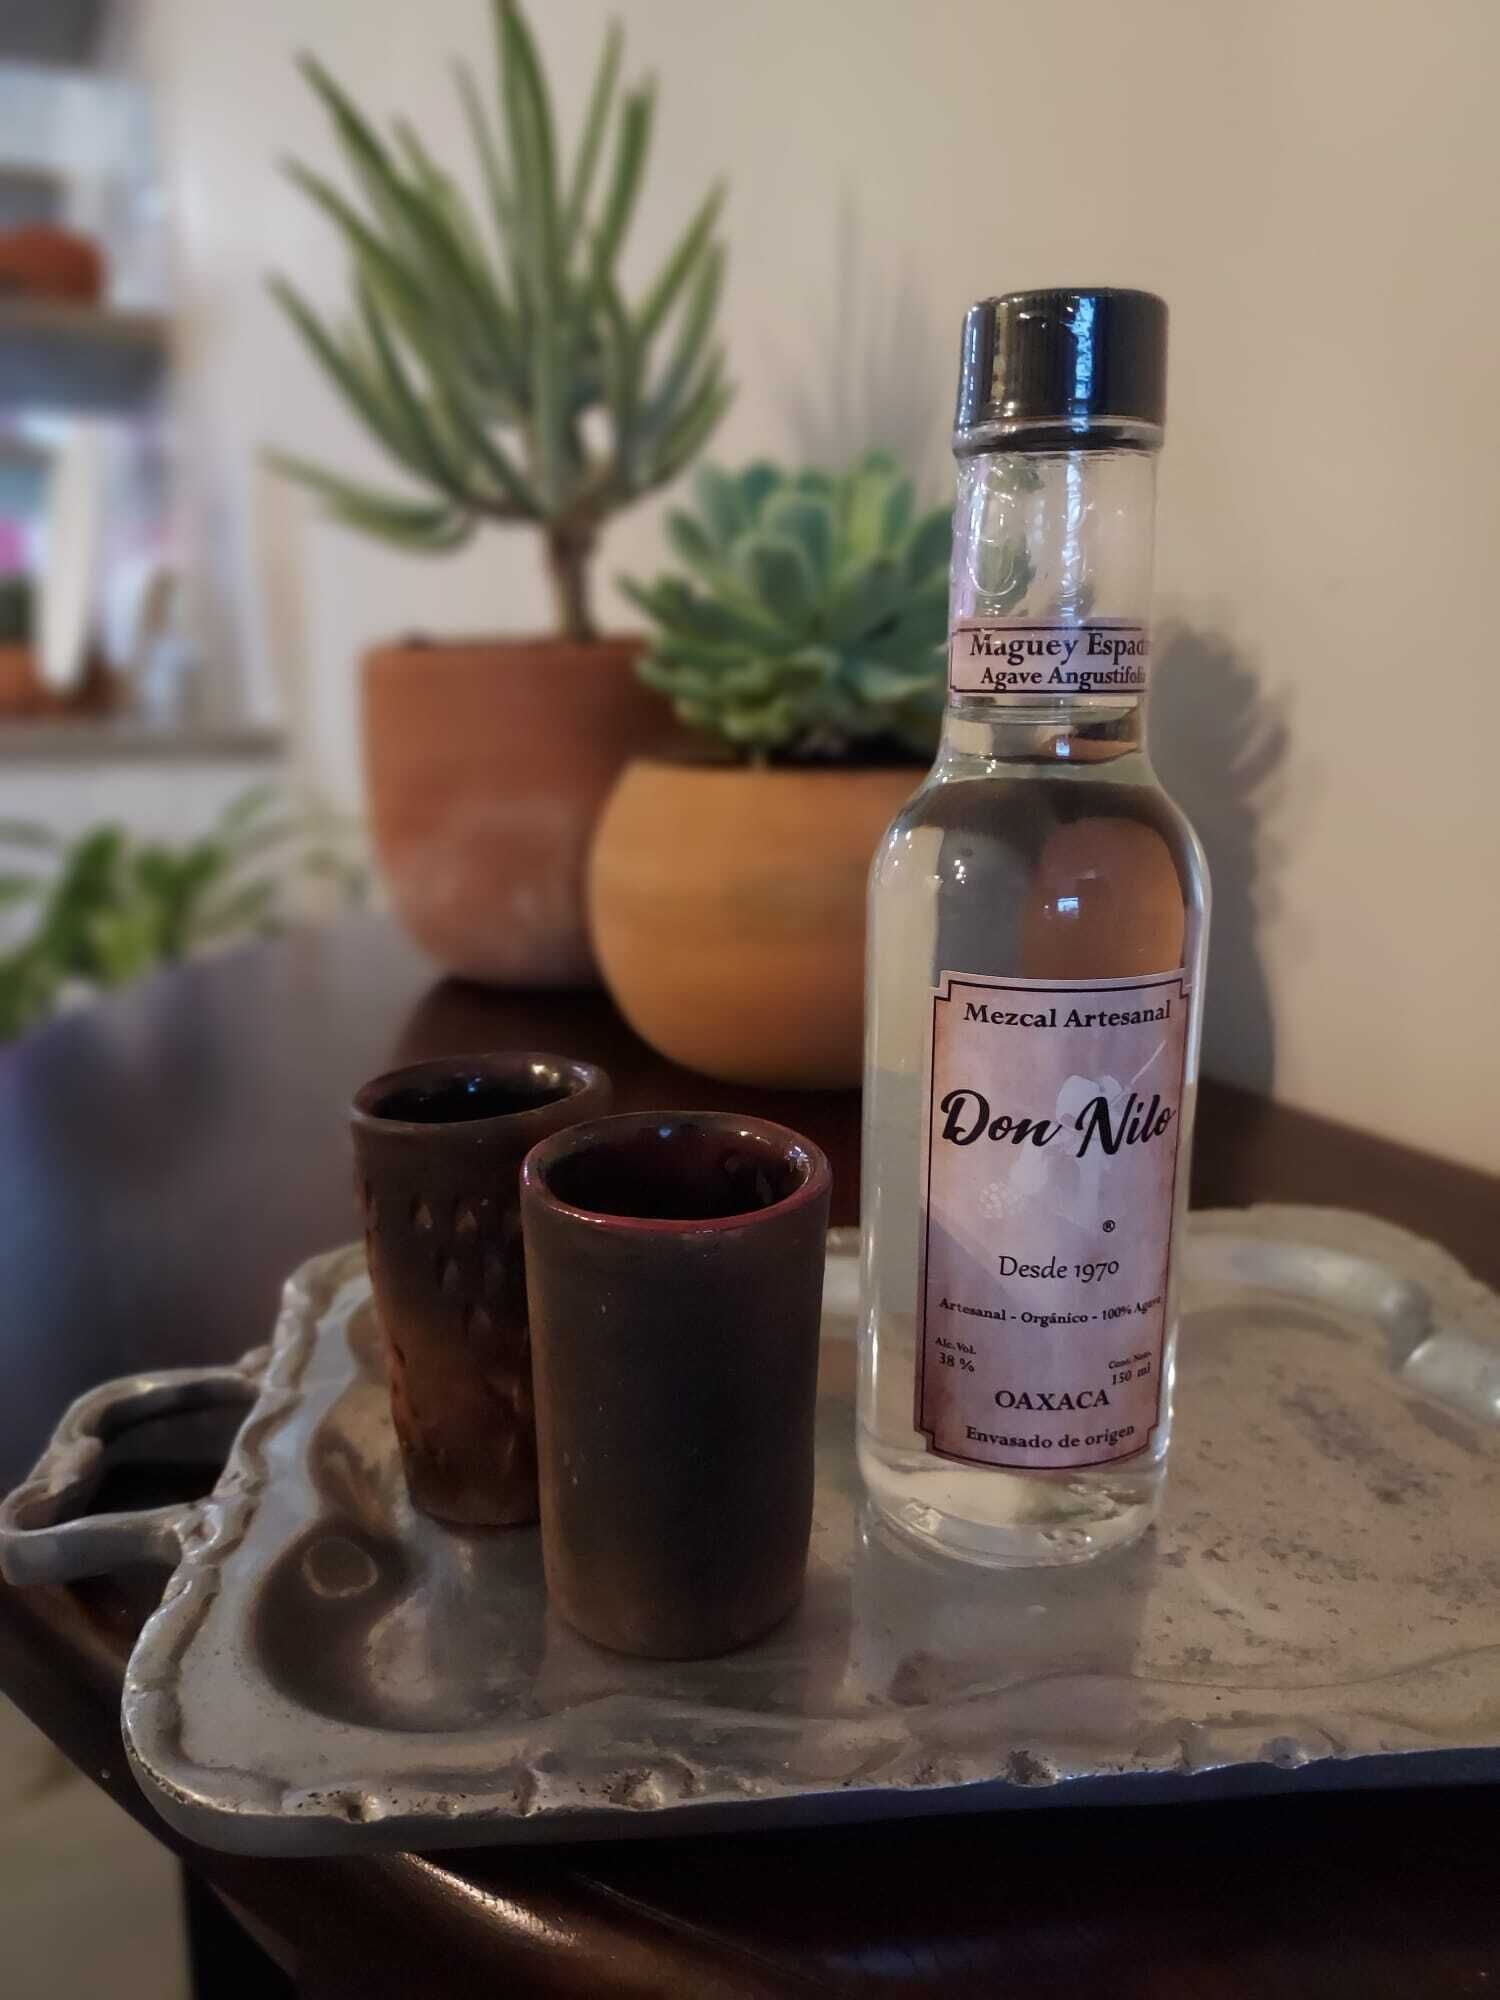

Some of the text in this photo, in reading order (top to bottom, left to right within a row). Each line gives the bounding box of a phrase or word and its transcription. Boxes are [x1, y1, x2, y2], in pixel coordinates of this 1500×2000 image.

[969, 631, 1150, 666] Maguey Espad
[980, 666, 1042, 691] Agave
[963, 1000, 1171, 1028] Mezcal Artesanal
[940, 1089, 1176, 1158] Don Nilo
[998, 1255, 1119, 1283] Desde 1970
[939, 1298, 1006, 1321] Artesanal
[1021, 1311, 1088, 1328] Orgánico
[1103, 1304, 1132, 1321] 100%
[939, 1351, 975, 1372] 38 %
[1111, 1369, 1132, 1385] 150
[995, 1389, 1110, 1411] OAXACA
[966, 1424, 1135, 1449] Envasado de origen
